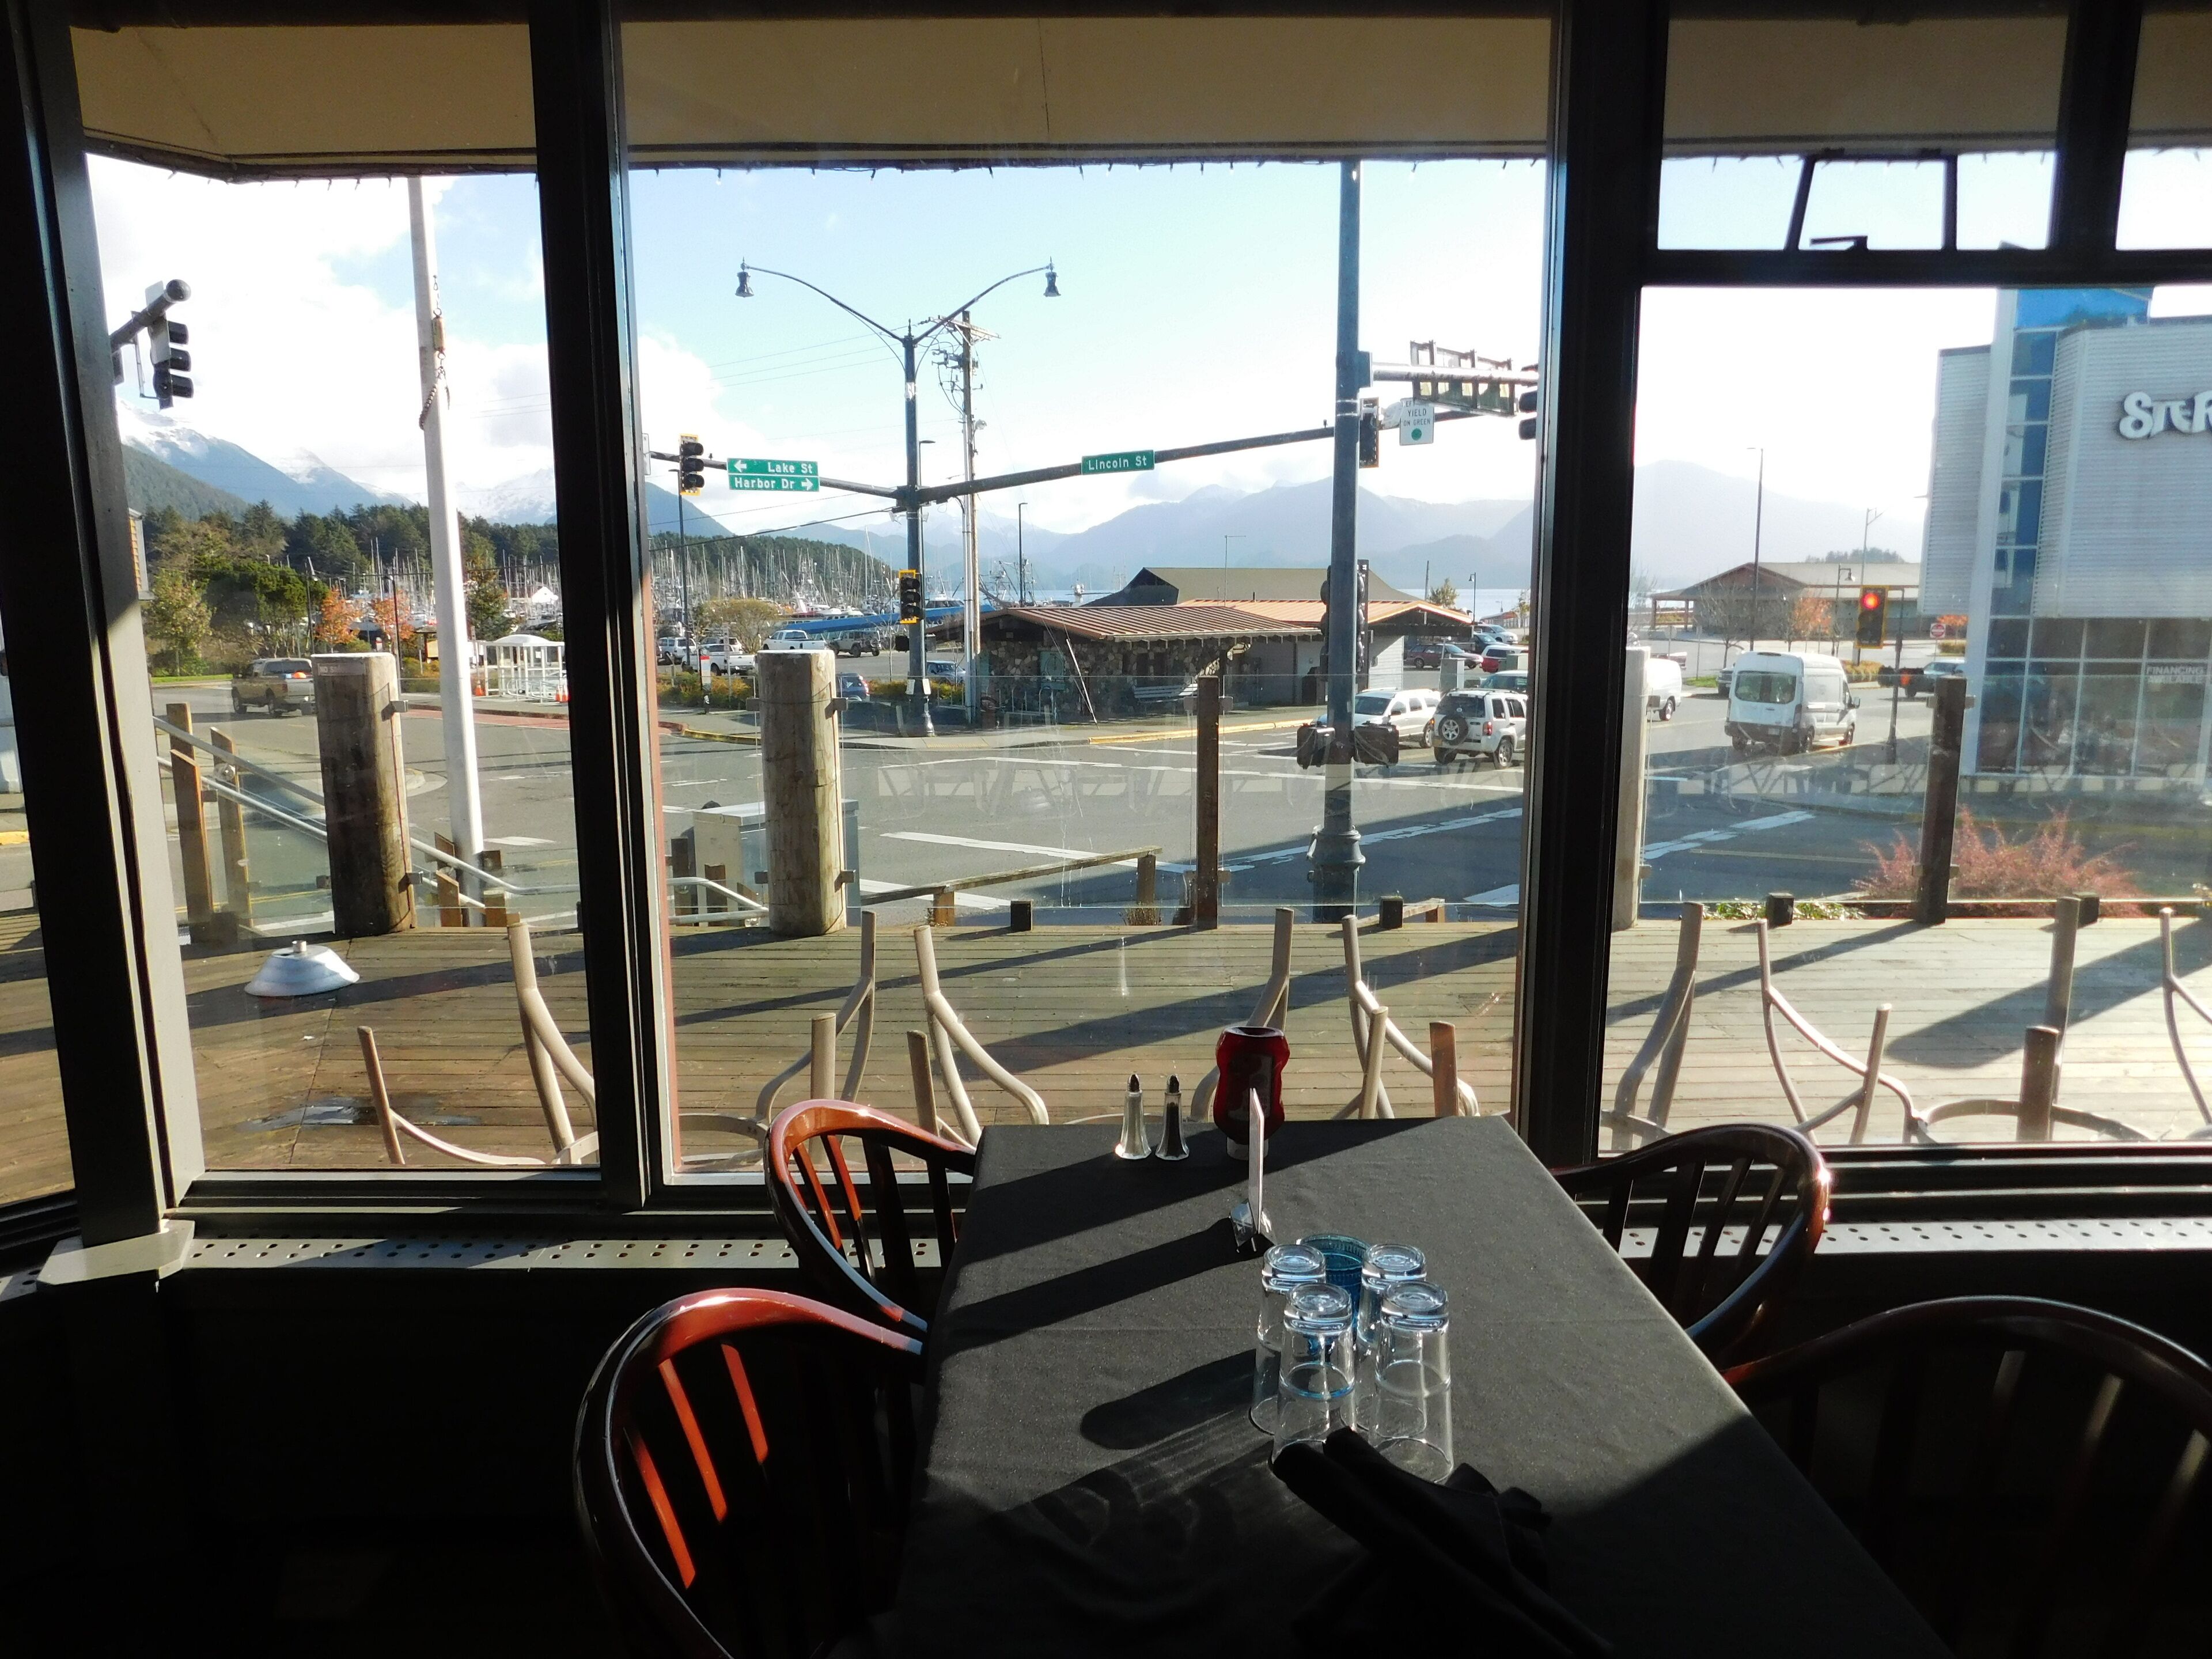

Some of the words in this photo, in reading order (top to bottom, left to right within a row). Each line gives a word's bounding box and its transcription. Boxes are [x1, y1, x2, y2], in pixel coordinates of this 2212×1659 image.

[1407, 408, 1427, 417] YIELD
[1413, 418, 1430, 426] GREEN
[767, 461, 795, 474] Lake
[801, 463, 813, 474] St
[1088, 457, 1129, 471] Lincoln
[1135, 455, 1147, 467] St
[734, 477, 776, 489] Harbor
[781, 478, 795, 489] Dr
[2146, 666, 2203, 675] FINANCING
